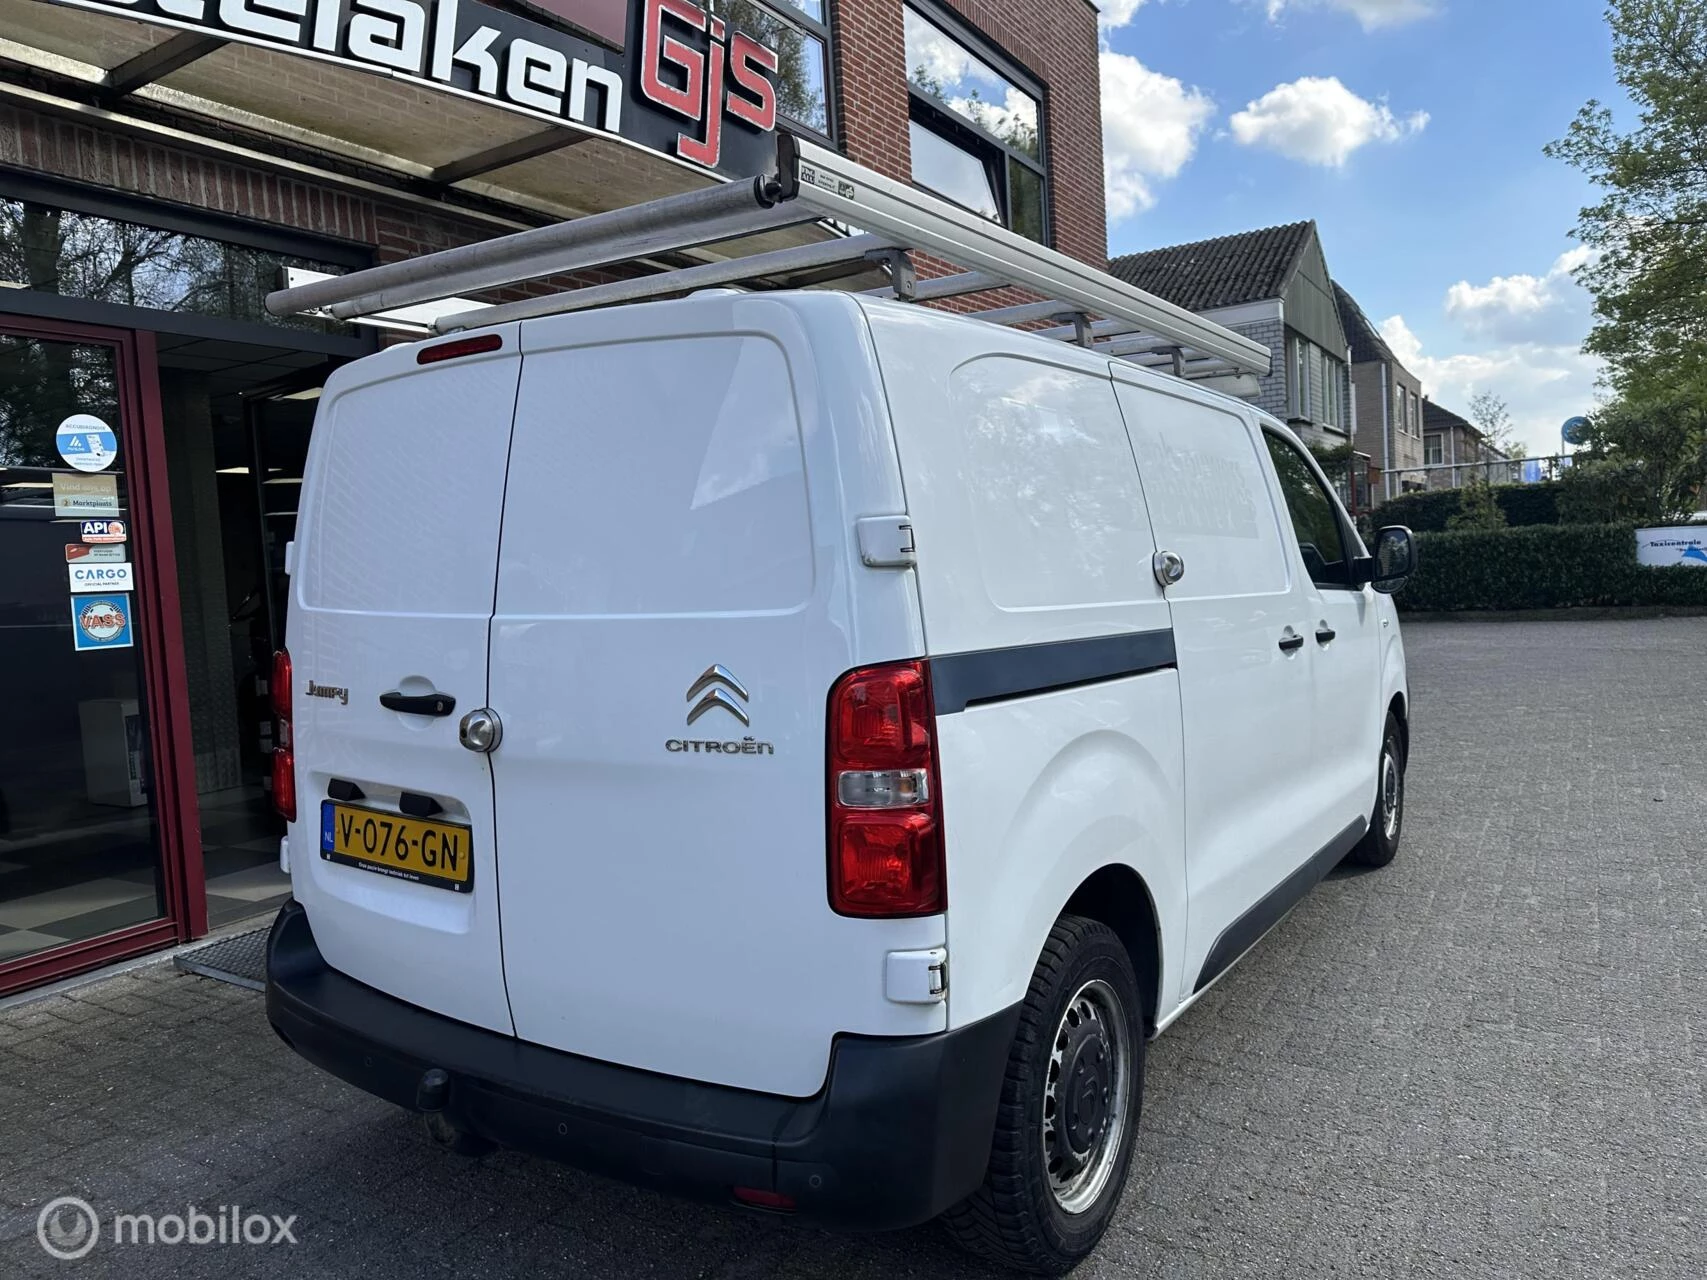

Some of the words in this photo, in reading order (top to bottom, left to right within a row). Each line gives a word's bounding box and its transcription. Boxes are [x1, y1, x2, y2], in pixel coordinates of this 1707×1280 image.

[72, 499, 113, 507] Marktplaats
[83, 522, 108, 534] API
[75, 568, 127, 580] CARGO
[79, 613, 126, 630] VASS
[305, 680, 349, 705] Jumpy
[324, 832, 334, 843] NL
[341, 813, 458, 871] V-076-GN
